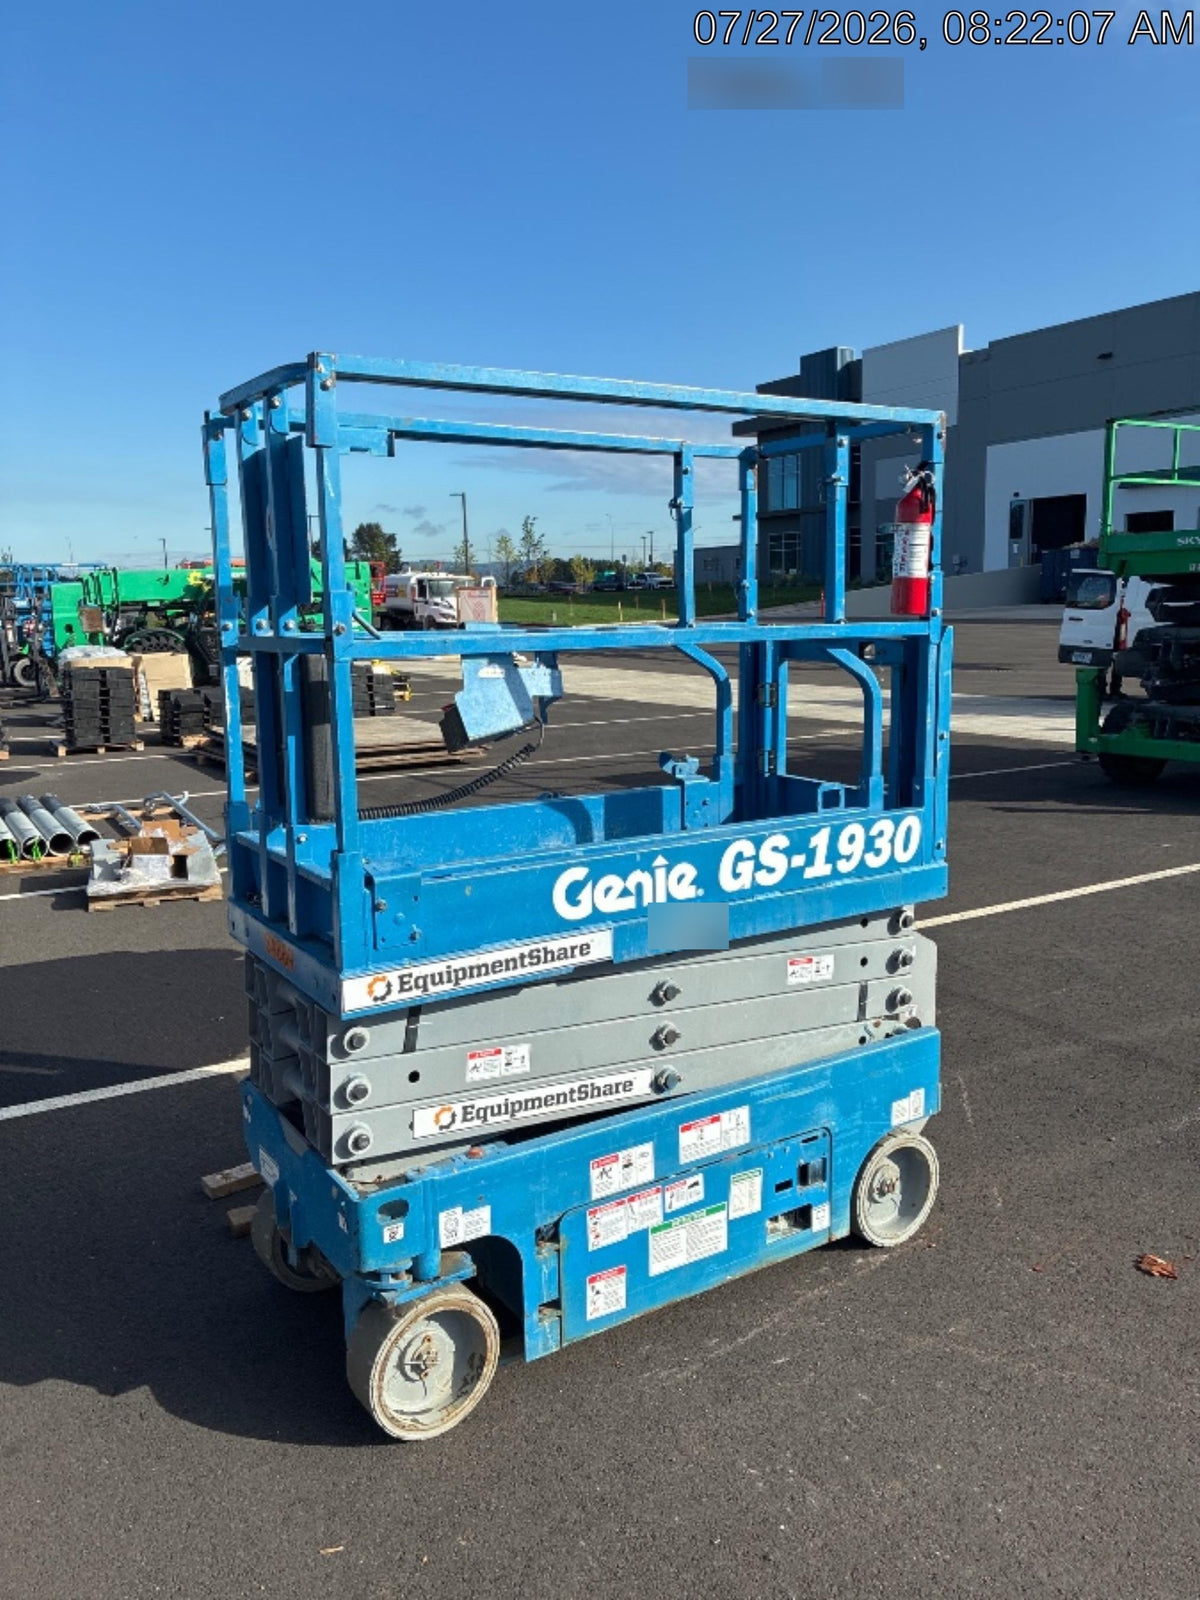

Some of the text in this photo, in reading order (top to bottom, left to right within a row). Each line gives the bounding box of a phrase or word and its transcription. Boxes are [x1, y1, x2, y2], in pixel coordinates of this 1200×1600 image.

[552, 815, 921, 920] Genie GS-1930
[397, 940, 592, 995] EquipmentShare
[461, 1078, 634, 1123] EquipmentShare
